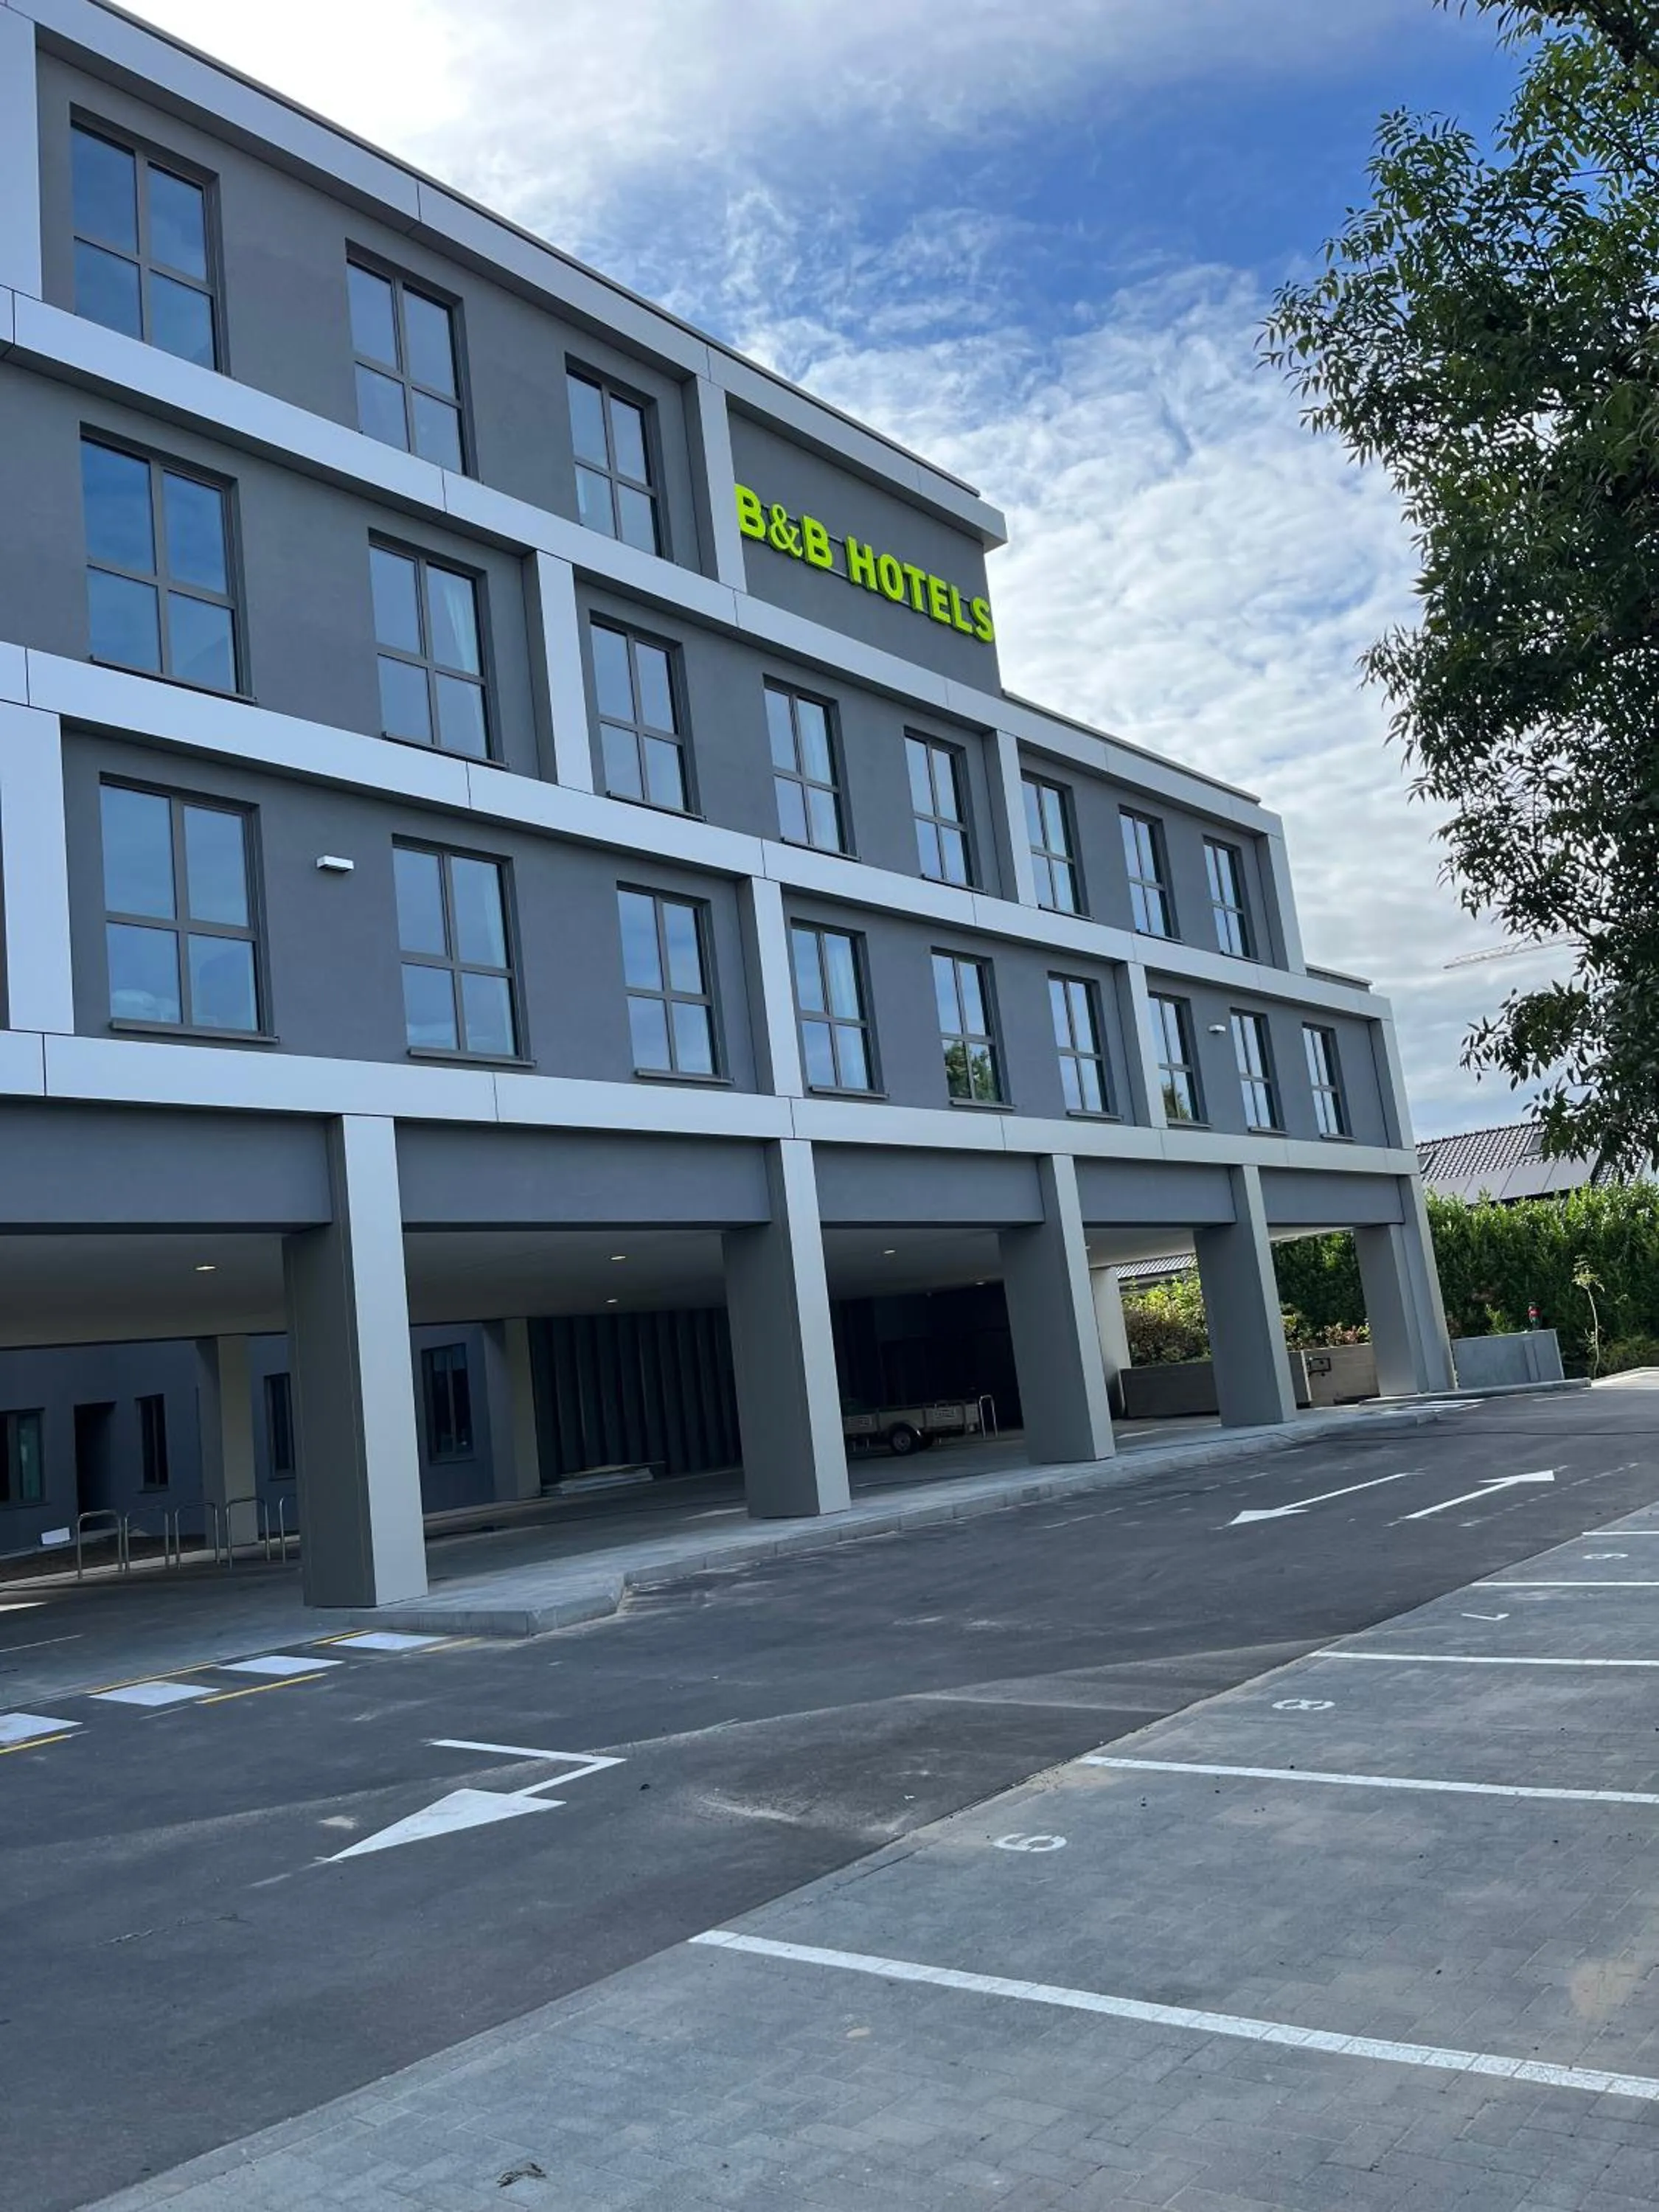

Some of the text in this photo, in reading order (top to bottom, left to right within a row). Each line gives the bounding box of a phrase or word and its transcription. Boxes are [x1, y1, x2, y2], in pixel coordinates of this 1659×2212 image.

[734, 484, 994, 643] B&B HOTELS
[1272, 1699, 1335, 1710] 8
